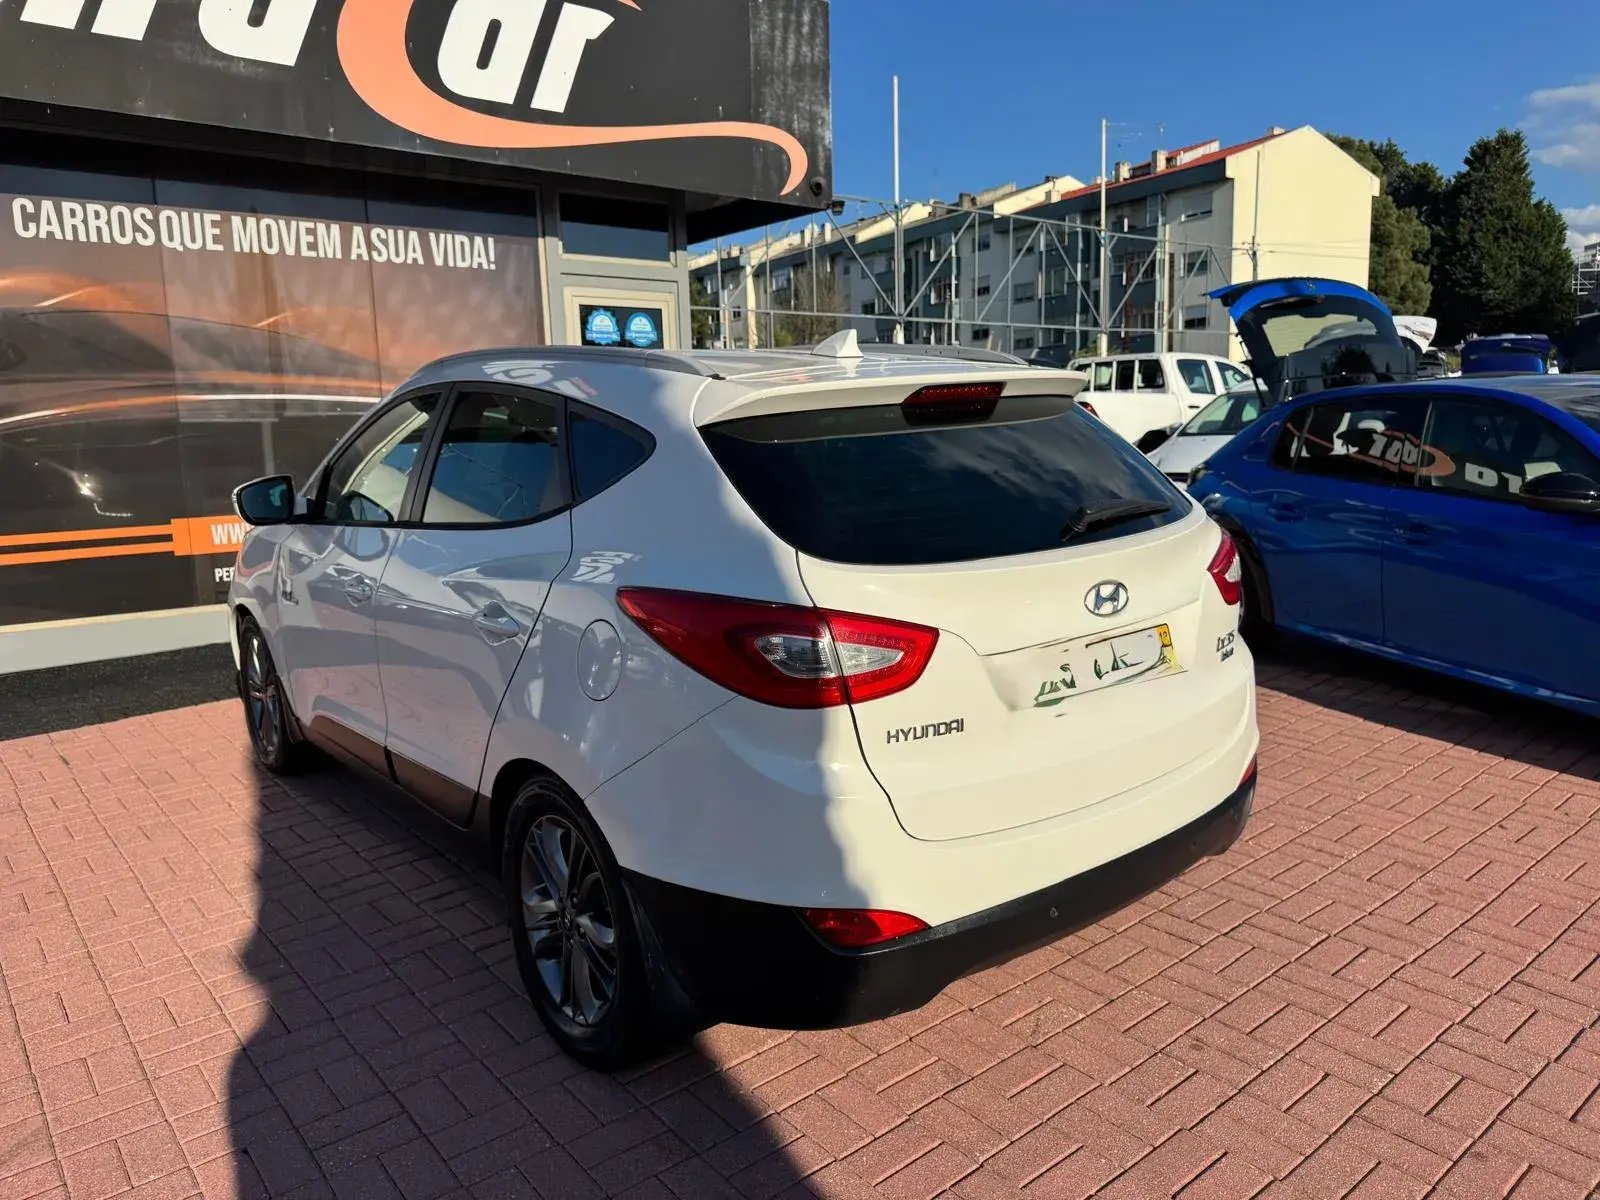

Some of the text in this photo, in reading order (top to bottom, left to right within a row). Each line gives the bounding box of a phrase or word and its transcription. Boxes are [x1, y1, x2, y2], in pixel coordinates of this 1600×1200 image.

[11, 197, 156, 247] CARROS
[158, 209, 225, 252] QUE
[230, 215, 343, 260] MOVEM
[428, 231, 497, 271] VIDA!
[210, 522, 255, 545] WW
[886, 717, 965, 744] HYUNDAI
